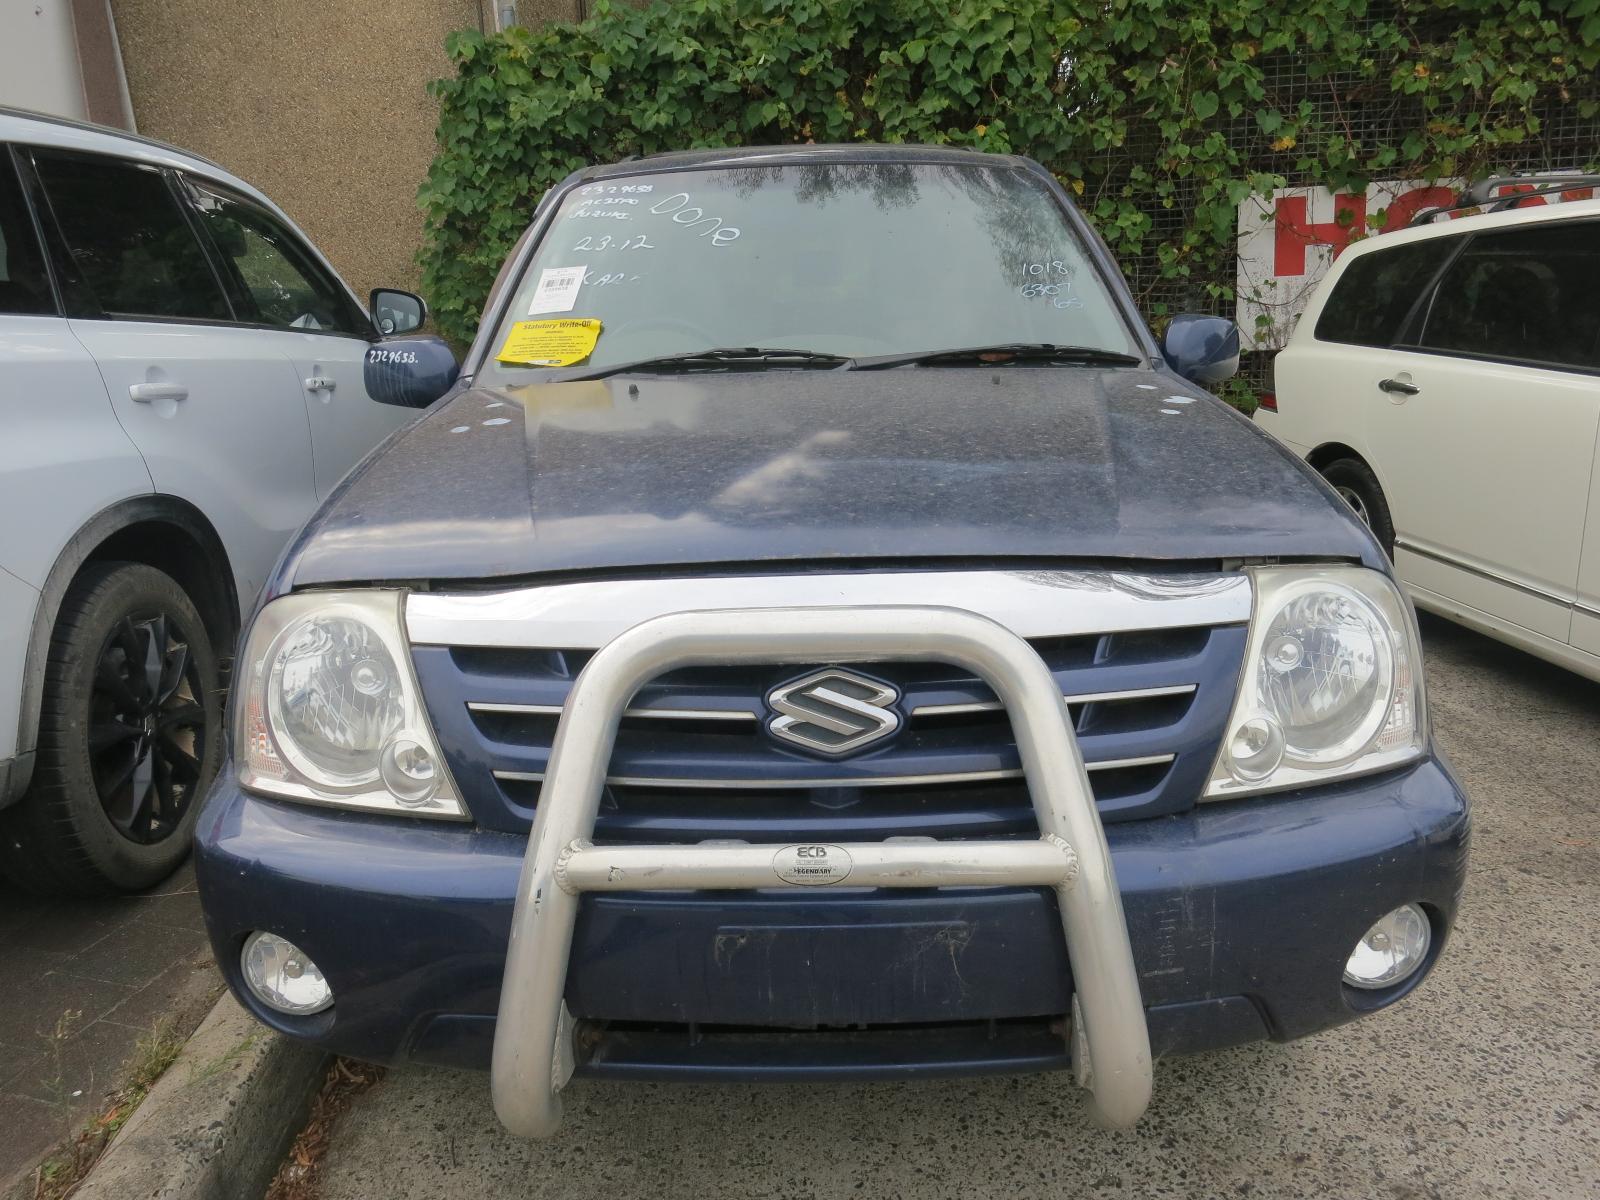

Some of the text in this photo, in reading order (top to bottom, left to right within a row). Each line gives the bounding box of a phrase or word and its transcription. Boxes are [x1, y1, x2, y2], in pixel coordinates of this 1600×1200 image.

[649, 192, 741, 247] Done
[1022, 260, 1069, 276] 1018
[1020, 282, 1071, 298] 6307
[523, 322, 559, 330] Statutory
[797, 846, 827, 858] ECB
